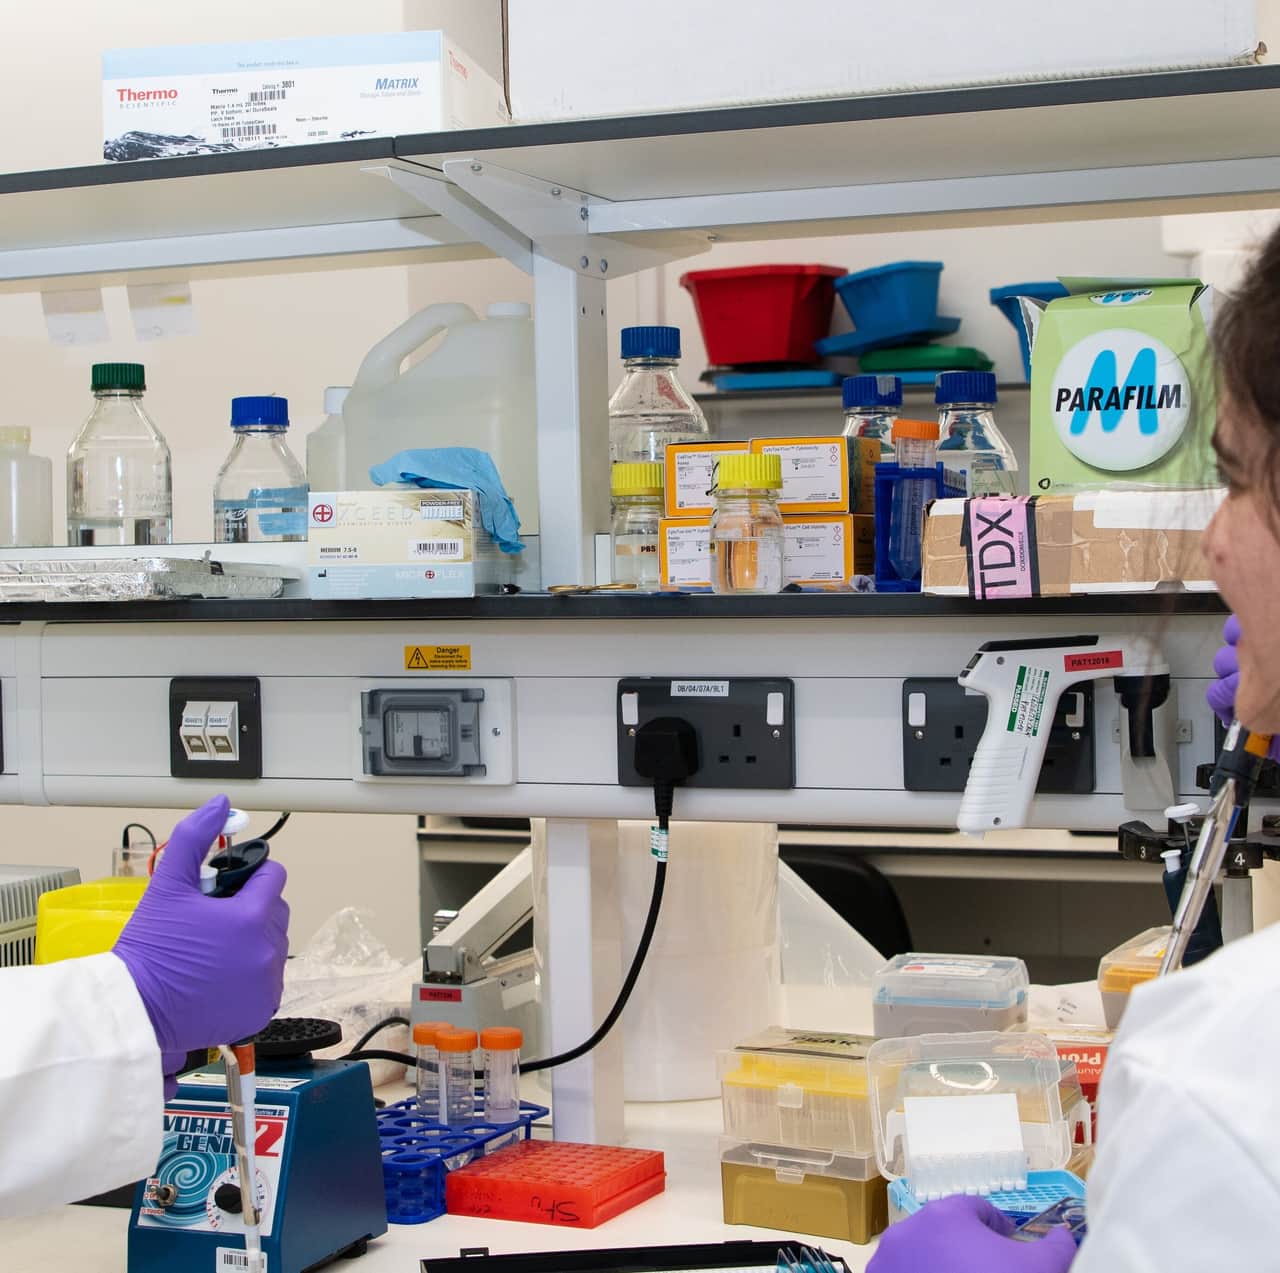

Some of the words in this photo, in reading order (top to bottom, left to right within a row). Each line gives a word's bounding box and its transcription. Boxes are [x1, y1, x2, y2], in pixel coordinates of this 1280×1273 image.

[376, 78, 419, 90] MATRIX
[116, 88, 178, 102] Thermo
[119, 101, 177, 110] SCIENTIFIC
[1055, 384, 1182, 412] PARAFILM
[640, 545, 657, 553] PBS
[976, 508, 1017, 599] TDX
[435, 647, 460, 655] Danger
[1011, 684, 1023, 713] PASSED
[1139, 846, 1147, 860] 3
[1234, 852, 1246, 866] 4
[164, 1115, 235, 1135] VORTE
[176, 1134, 239, 1154] GENI
